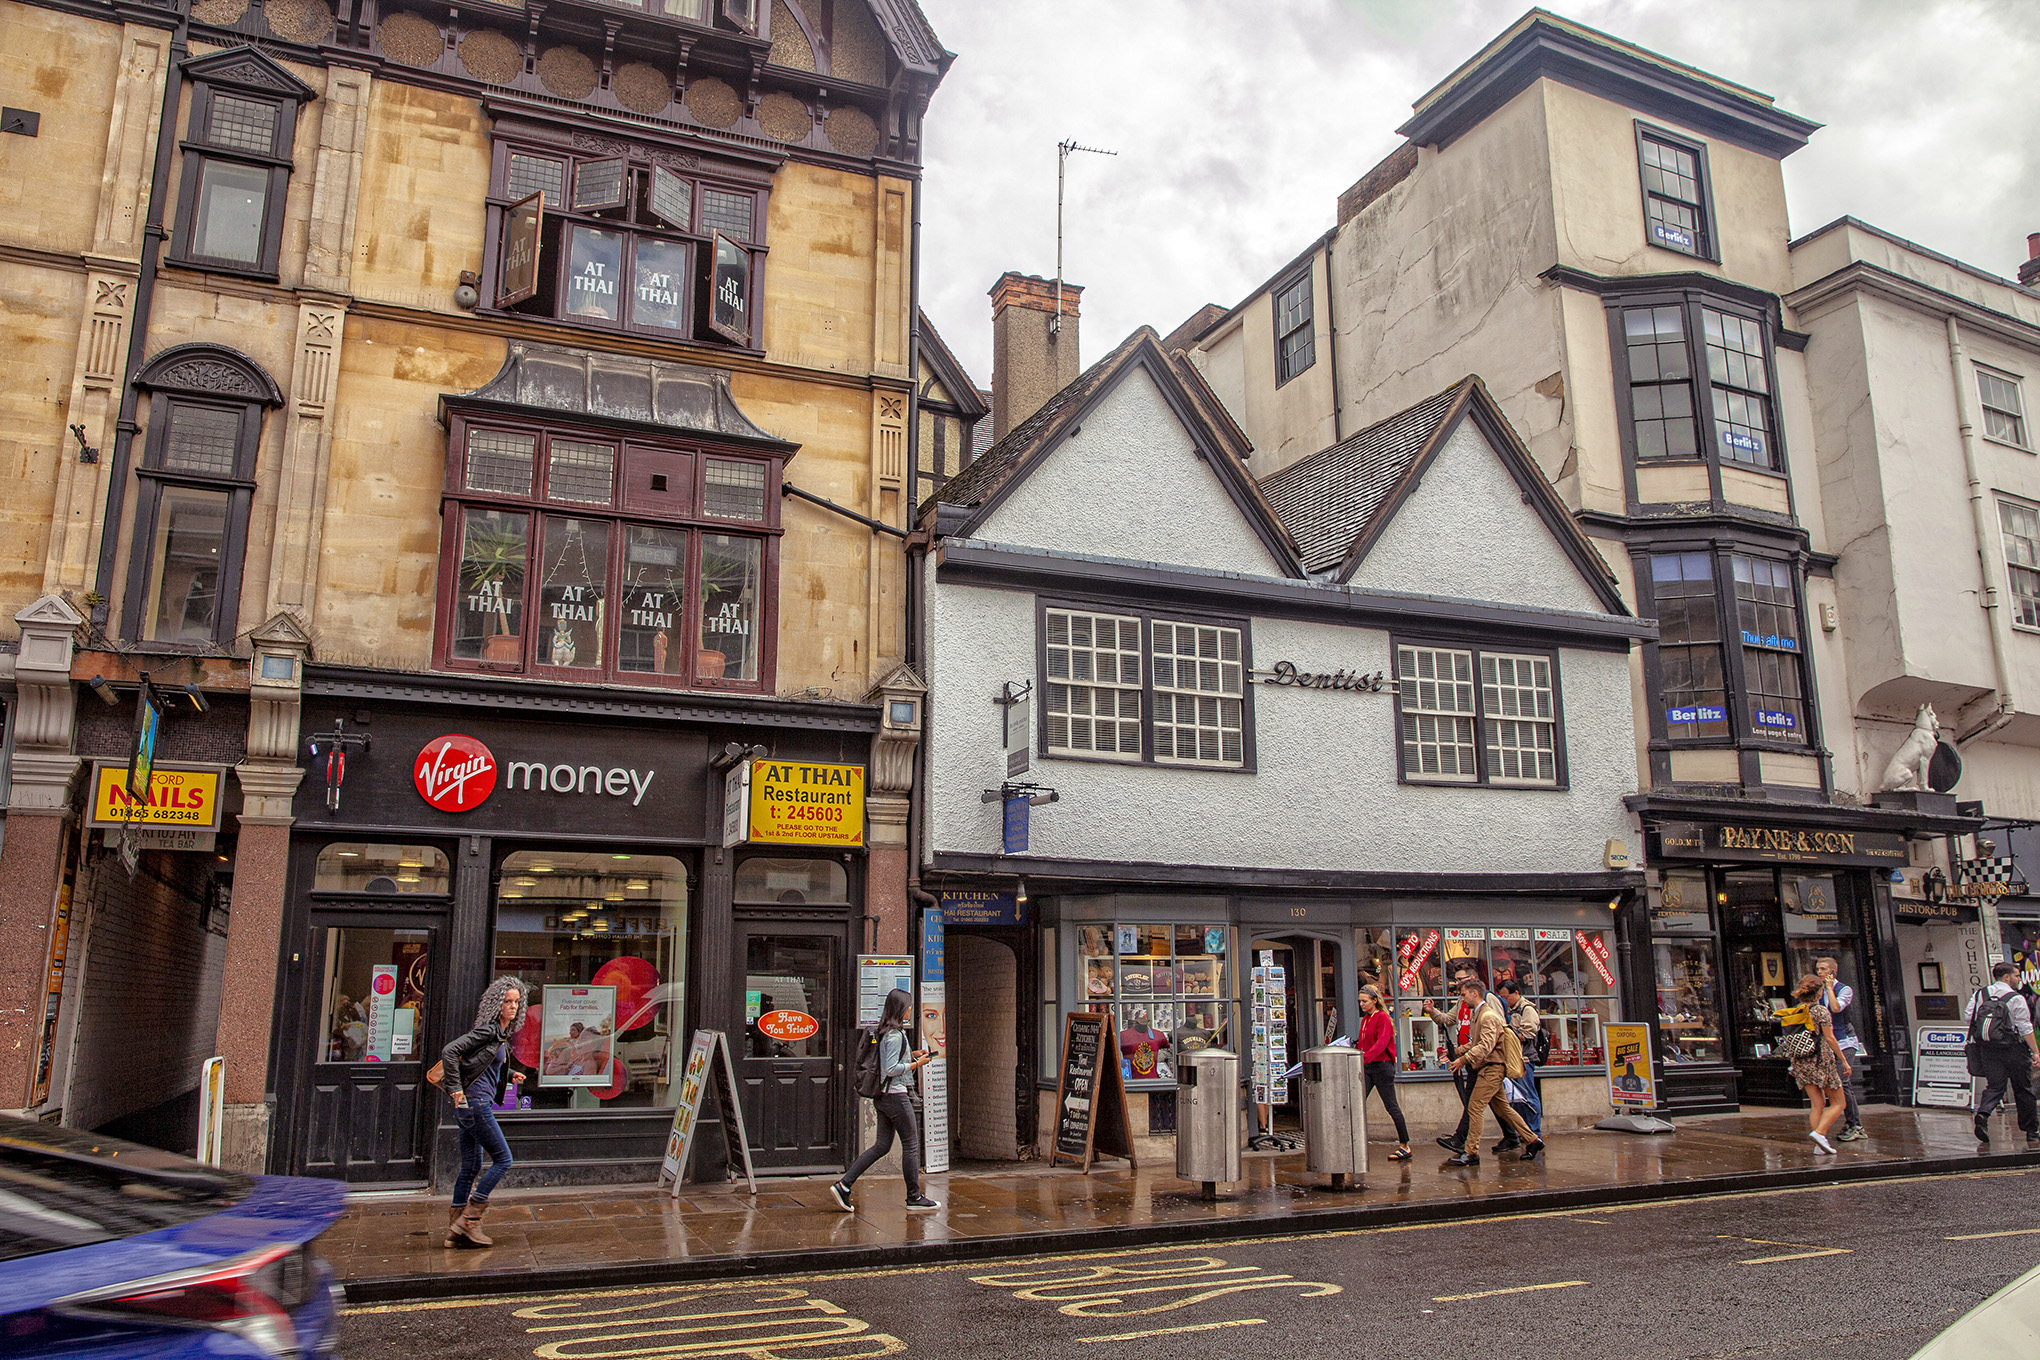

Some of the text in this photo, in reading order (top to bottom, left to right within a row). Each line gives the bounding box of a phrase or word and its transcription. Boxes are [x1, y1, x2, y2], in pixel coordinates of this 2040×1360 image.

[512, 236, 526, 252] AT
[1658, 228, 1690, 246] Berlitz
[506, 248, 531, 272] THAI
[584, 262, 605, 276] AT
[574, 274, 614, 294] THAI
[650, 272, 670, 288] AT
[725, 276, 738, 292] AT
[640, 284, 678, 306] THAI
[718, 286, 744, 312] THAI
[1726, 434, 1760, 451] Berlitz
[479, 580, 502, 597] AT
[562, 586, 585, 602] AT
[468, 595, 512, 614] THAI
[642, 592, 664, 609] AT
[550, 602, 594, 622] THAI
[718, 602, 740, 618] AT
[630, 610, 672, 629] THAI
[708, 616, 749, 635] THAI
[1264, 660, 1383, 692] Dentist
[1672, 708, 1722, 721] Berlitz
[1758, 712, 1792, 726] Berlitz
[151, 774, 184, 786] FORD
[419, 742, 655, 806] Virgin money
[766, 765, 852, 786] AT THAI
[764, 786, 852, 805] Restaurant
[153, 810, 200, 820] 682348
[770, 804, 843, 822] t: 245603
[804, 824, 814, 832] GO
[818, 832, 849, 840] UPSTAIRS
[159, 840, 194, 850] TEA BAR
[1723, 826, 1855, 854] PAYNE & SON
[942, 892, 999, 900] KITCHEN
[1290, 908, 1306, 916] 130
[1899, 904, 1958, 916] HISTORIC PUB
[1458, 930, 1482, 938] SALE
[1504, 930, 1527, 939] SALE
[1546, 930, 1568, 940] SALE
[1958, 928, 1978, 936] THE
[1402, 934, 1418, 956] UP TO
[1594, 938, 1609, 958] UP TO
[1400, 932, 1438, 989] 50% REDUCTIONS
[1576, 932, 1614, 985] 50% REDUCTIONS
[786, 976, 804, 984] THAI
[778, 1012, 802, 1022] Have
[766, 1023, 814, 1034] You Tried?
[1930, 1033, 1962, 1042] Berlitz
[1616, 1045, 1638, 1056] BIG SALE
[1074, 1078, 1088, 1091] OPEN
[968, 1256, 1344, 1318] BUS
[511, 1288, 908, 1360] STOP
